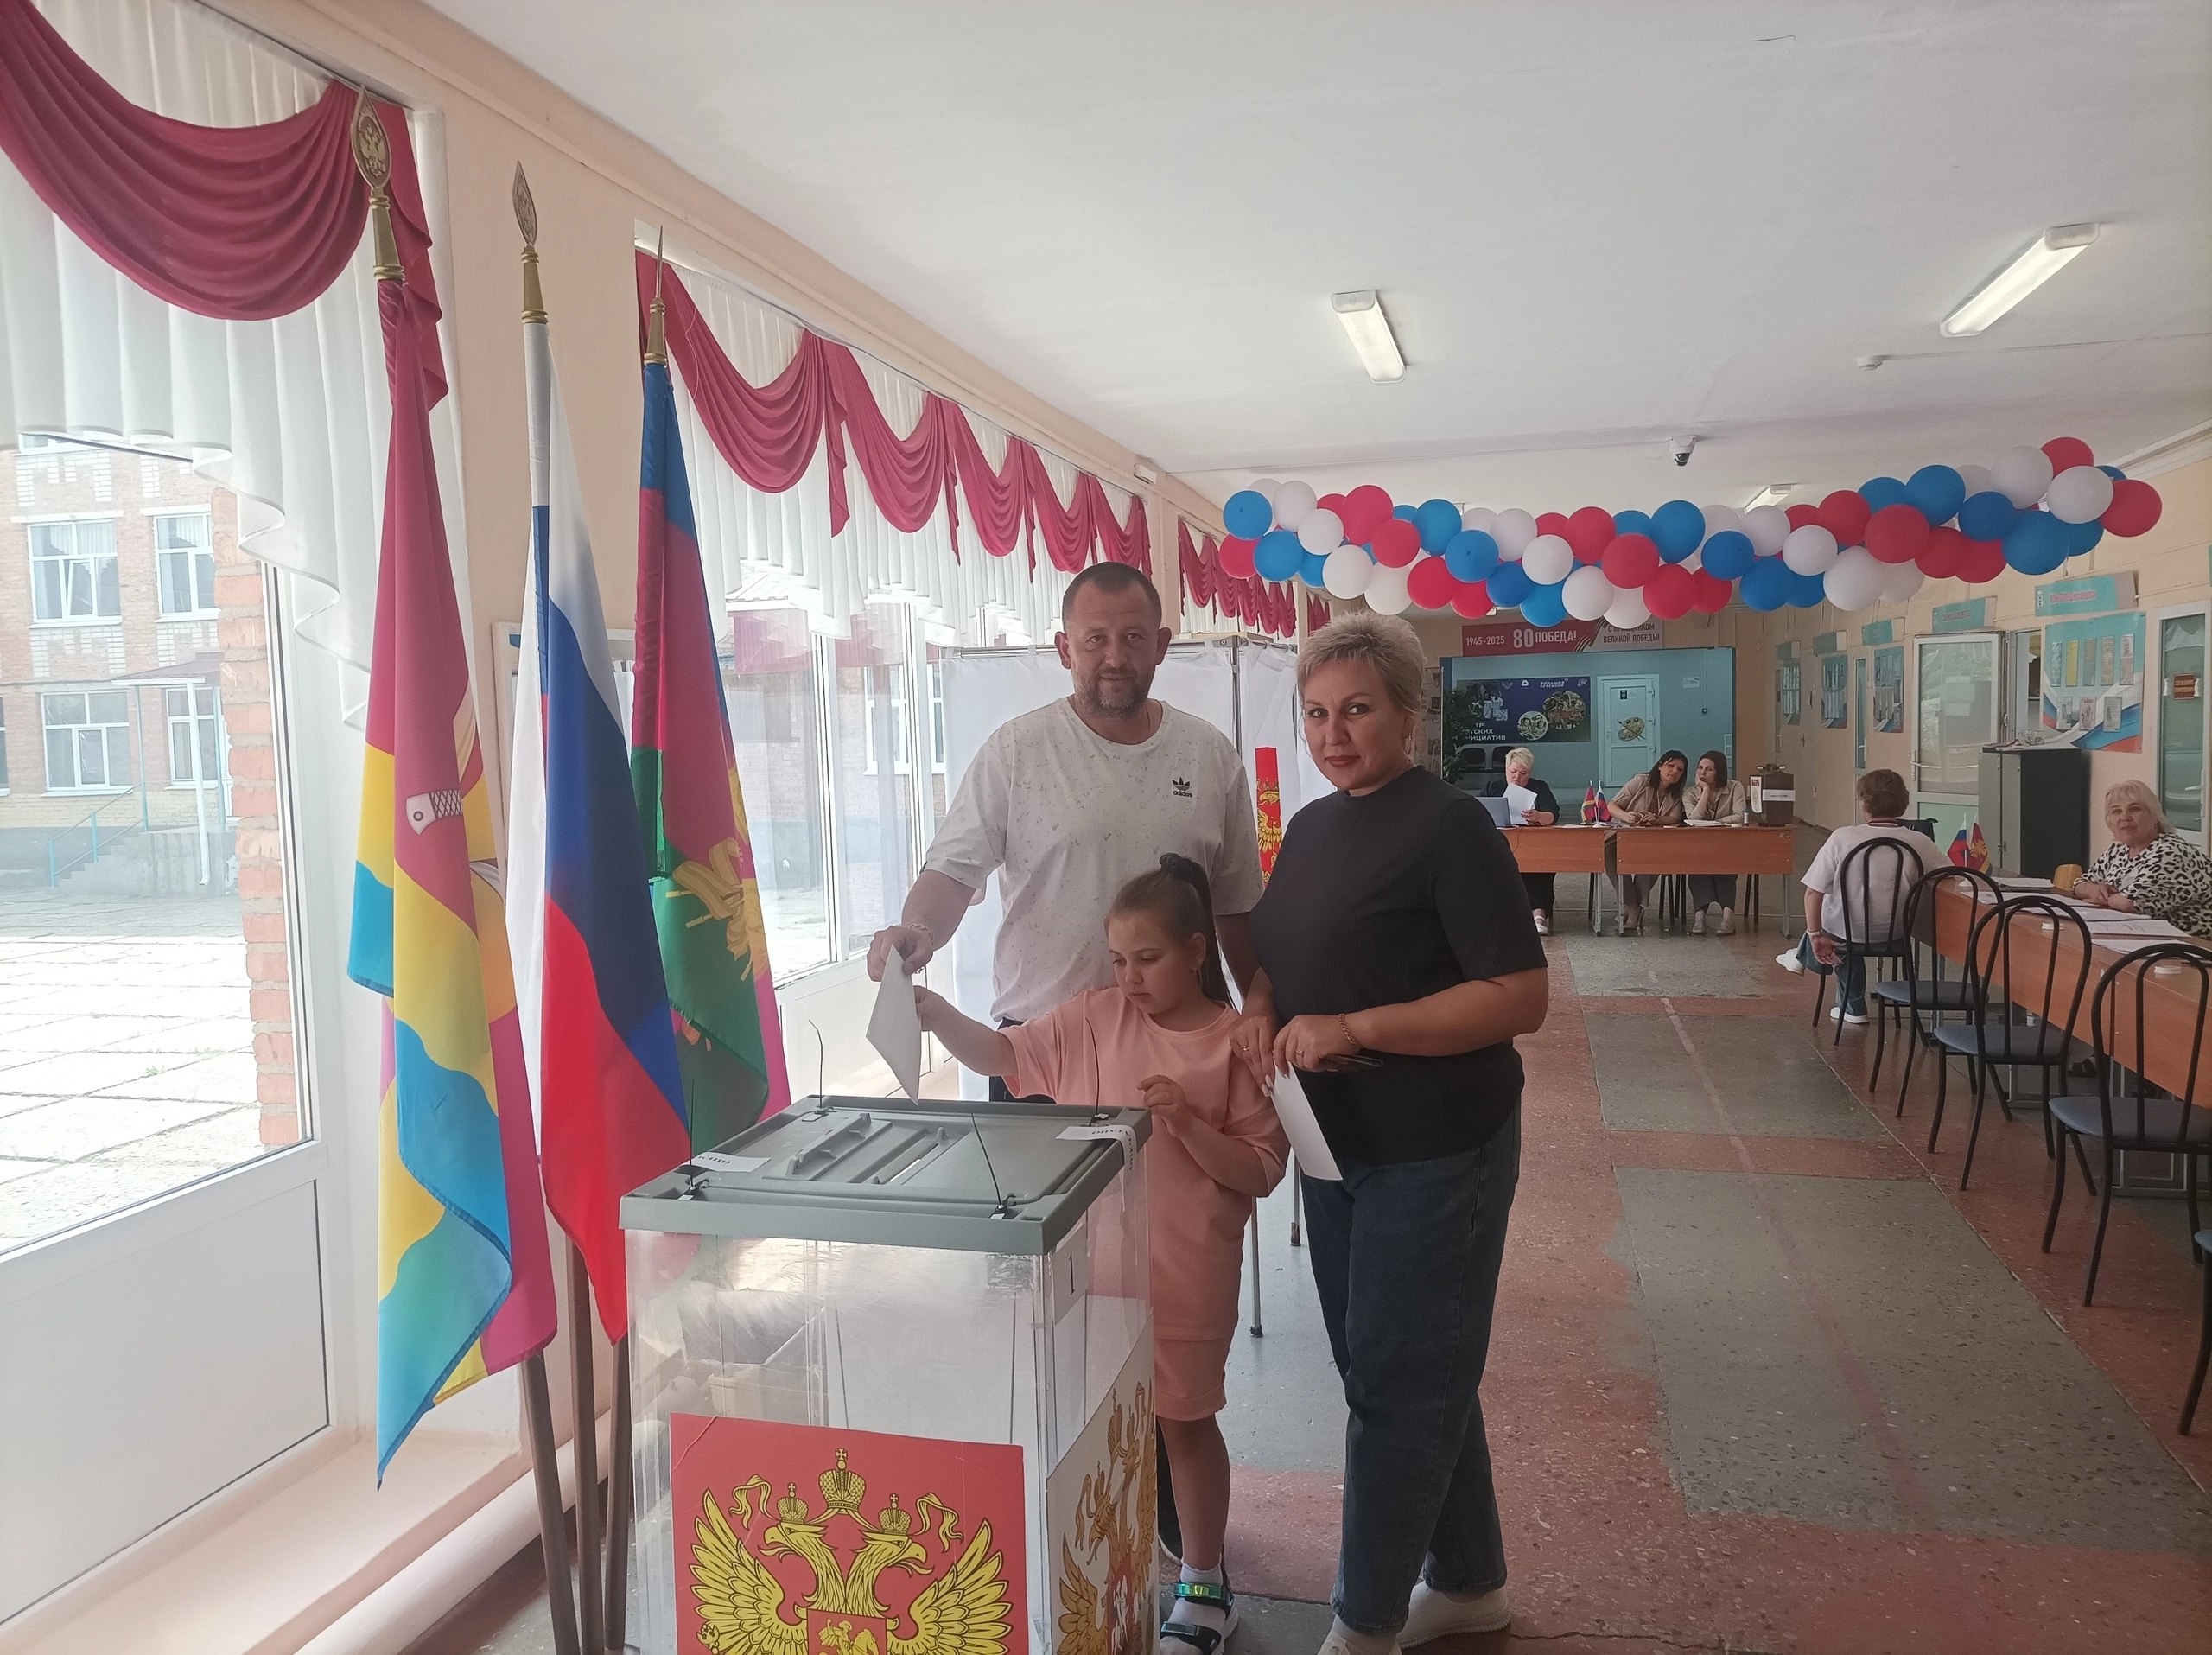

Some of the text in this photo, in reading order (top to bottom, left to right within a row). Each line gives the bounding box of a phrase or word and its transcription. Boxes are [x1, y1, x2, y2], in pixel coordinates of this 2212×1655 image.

[1465, 635, 1505, 646] 1945-2025
[1513, 628, 1577, 649] 80 ПОБЕДА!
[1603, 633, 1660, 643] ВЕЛИКОЙ ПОБЕДЫ!
